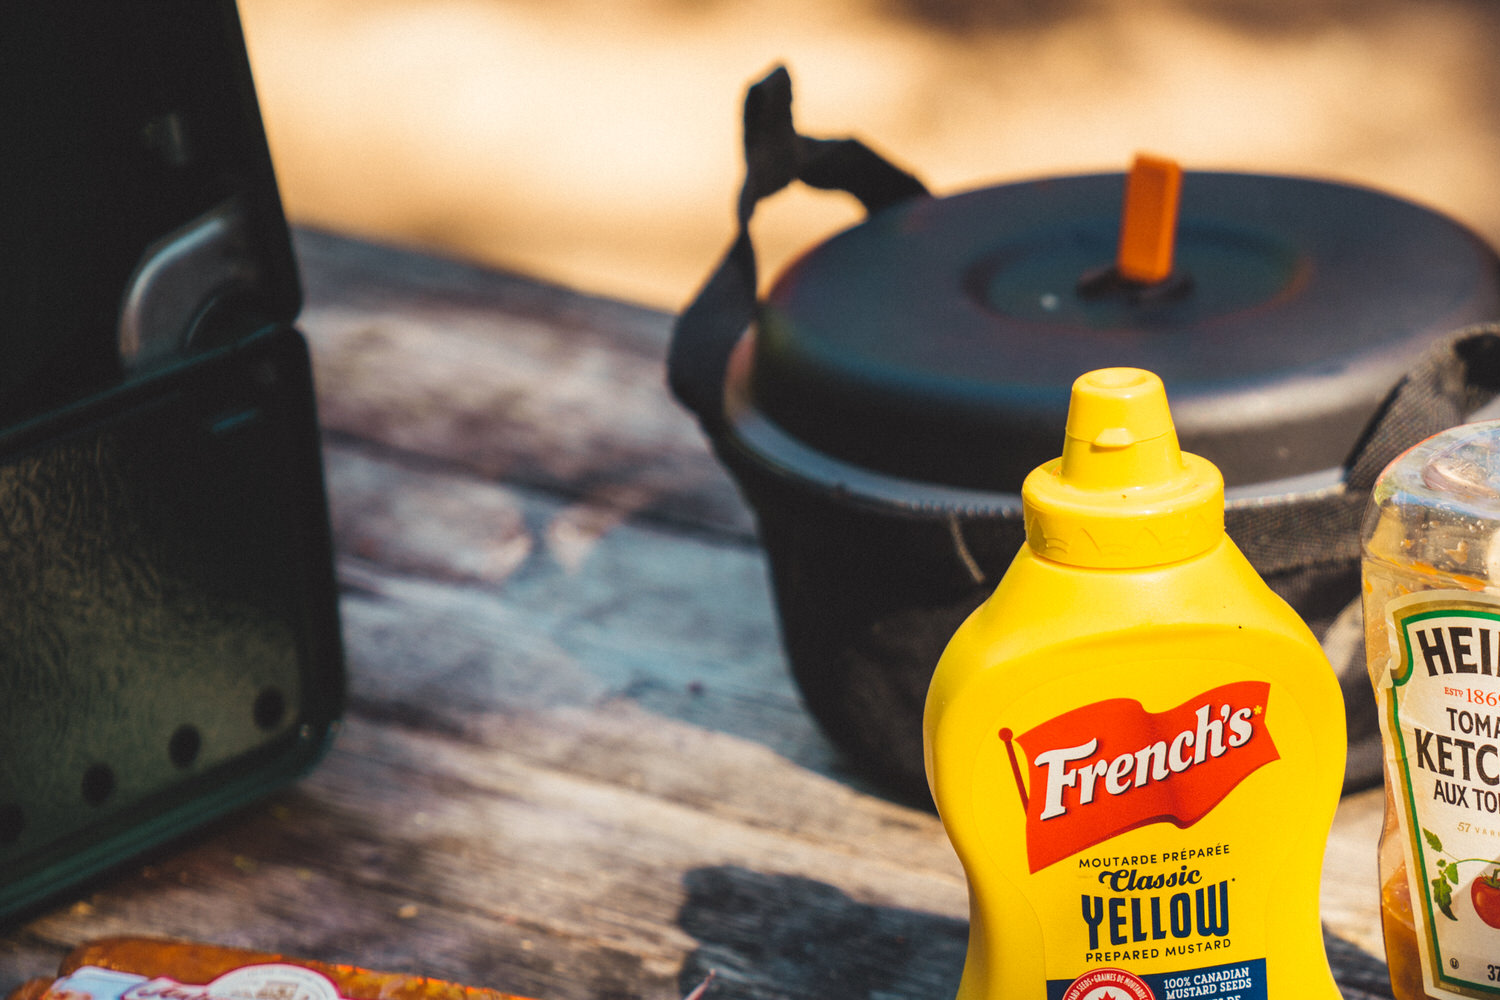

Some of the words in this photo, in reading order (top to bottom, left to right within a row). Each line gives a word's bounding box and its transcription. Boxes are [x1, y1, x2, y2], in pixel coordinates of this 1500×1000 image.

[1034, 703, 1254, 821] French's
[1434, 779, 1470, 808] AUX
[1457, 821, 1471, 833] 57
[1079, 854, 1157, 868] MOUTARDE
[1163, 843, 1230, 863] PRÉPARÉE
[1098, 865, 1203, 892] Classic
[1081, 880, 1230, 951] YELLOW
[1086, 948, 1159, 963] PREPARED
[1165, 939, 1231, 957] MUSTARD
[1093, 973, 1116, 983] GRAINES
[1117, 974, 1124, 984] DE
[1123, 977, 1147, 1000] MOUTARDE
[1164, 976, 1191, 989] 100%
[1194, 967, 1249, 985] CANADIAN
[1166, 984, 1217, 1000] MUSTARD
[1220, 978, 1252, 992] SEEDS
